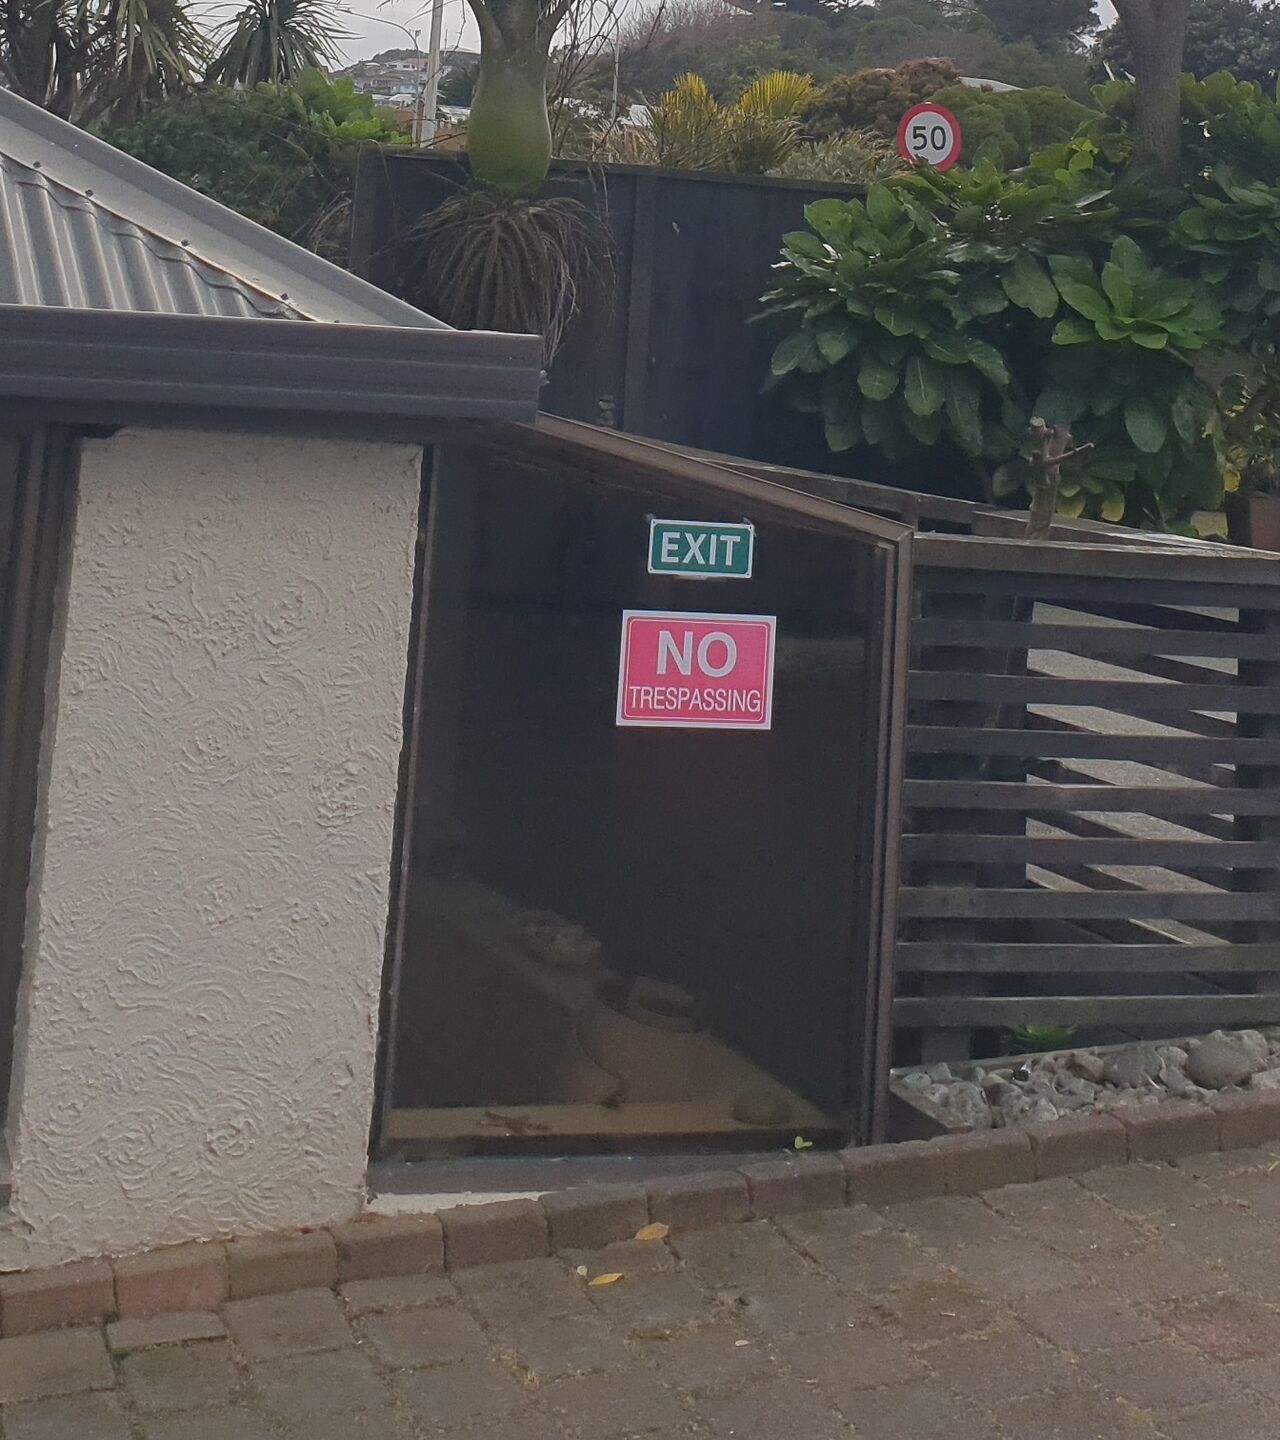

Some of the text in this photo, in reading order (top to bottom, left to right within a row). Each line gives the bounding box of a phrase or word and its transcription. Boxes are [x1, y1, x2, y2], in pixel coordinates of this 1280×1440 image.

[912, 125, 947, 151] 50
[660, 531, 741, 567] EXIT
[656, 630, 738, 678] NO
[629, 685, 762, 713] TRESPASSING
